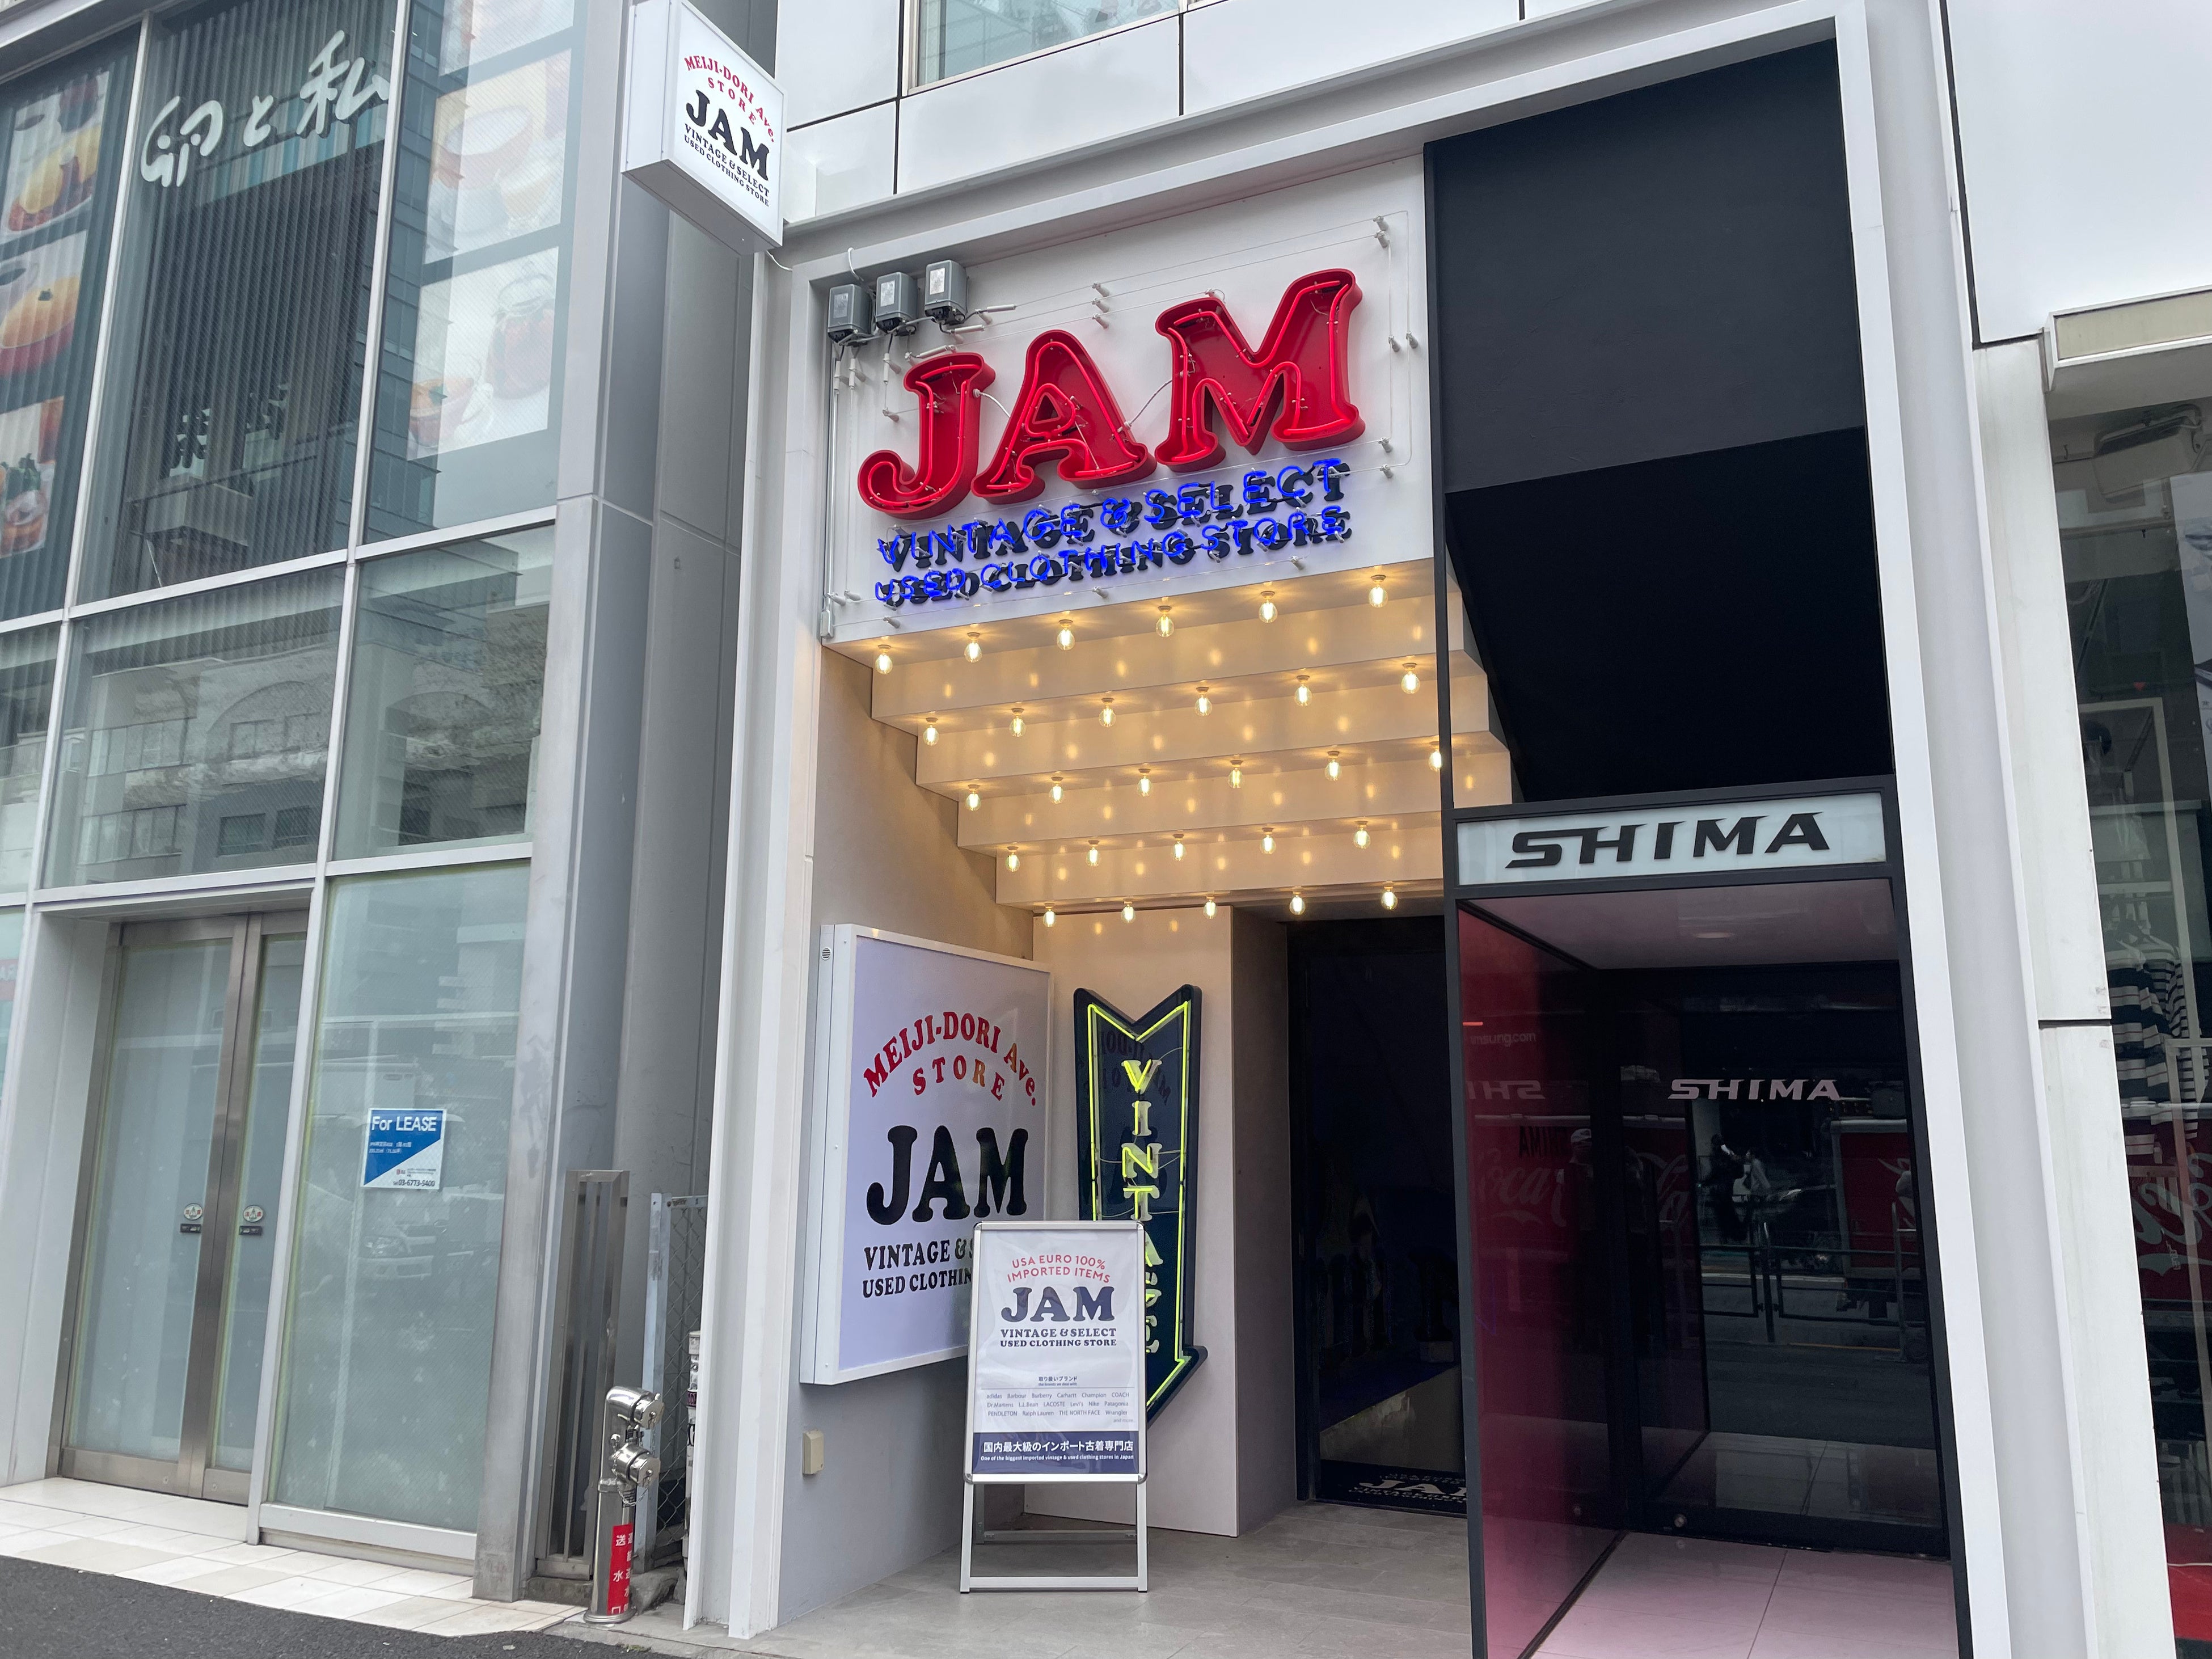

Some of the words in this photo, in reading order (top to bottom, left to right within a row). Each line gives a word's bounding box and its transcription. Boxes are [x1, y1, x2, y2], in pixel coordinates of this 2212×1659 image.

[141, 29, 390, 188] 卵と私
[684, 55, 754, 104] MEIJI-DORI
[755, 107, 774, 143] Ave.
[708, 77, 756, 125] STORE
[685, 123, 727, 164] VINTAGE
[729, 159, 736, 170] &
[736, 166, 769, 197] SELECT
[686, 89, 770, 181] JAM
[684, 134, 705, 156] USED
[706, 153, 744, 187] CLOTHING
[746, 184, 769, 207] STORE
[858, 268, 1366, 519] JAM
[877, 504, 1096, 572] VINTAGE
[1100, 497, 1143, 537] &
[1144, 458, 1351, 530] SELECT
[875, 567, 980, 607] USED
[981, 531, 1193, 592] CLOTHING
[1200, 505, 1353, 560] STORE
[1504, 811, 1830, 869] SHIMA
[863, 1011, 1001, 1098] MEIJI-DORI
[1003, 1042, 1036, 1107] Ave.
[913, 1055, 1005, 1101] STORE
[1668, 1079, 1841, 1100] SHIMA
[371, 1116, 392, 1131] For
[396, 1116, 437, 1132] LEASE
[866, 1125, 1029, 1225] JAM
[864, 1239, 950, 1271] VINTAGE
[955, 1238, 966, 1260] &
[1007, 1267, 1070, 1282] IMPORTED
[1075, 1267, 1111, 1283] ITEMS
[1012, 1256, 1036, 1268] USA
[1039, 1255, 1072, 1264] EURO
[1075, 1255, 1105, 1270] 100%
[863, 1276, 905, 1298] USED
[909, 1267, 972, 1292] CLOTHIN
[1001, 1286, 1115, 1323] JAM
[1001, 1329, 1057, 1337] VINTAGE
[1059, 1328, 1069, 1337] &
[1070, 1328, 1117, 1337] SELECT
[983, 1440, 1134, 1453] 国内最大級のインポート古着専門店
